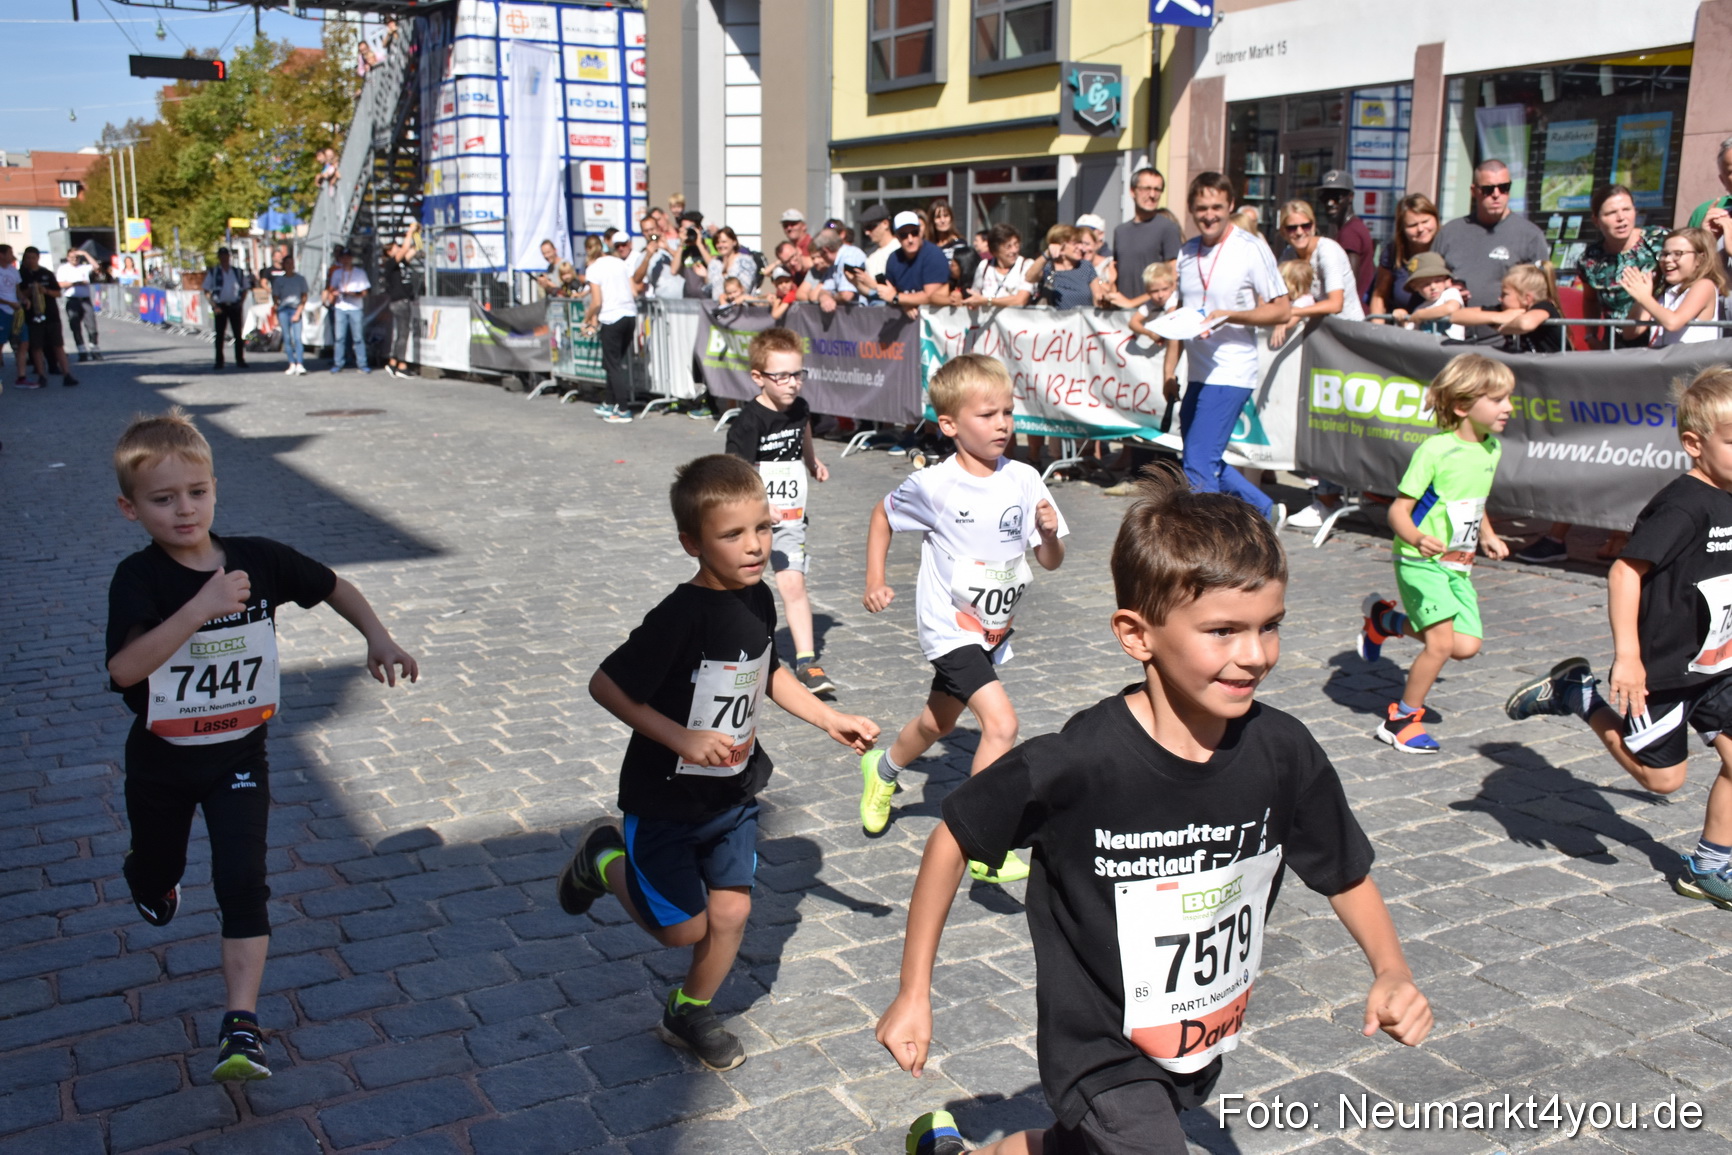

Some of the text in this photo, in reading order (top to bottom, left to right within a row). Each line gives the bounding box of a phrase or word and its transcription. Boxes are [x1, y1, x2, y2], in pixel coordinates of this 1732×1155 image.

[1215, 40, 1288, 65] Unterer Markt 15
[1351, 420, 1364, 438] by
[1367, 427, 1400, 441] smart
[1527, 440, 1692, 470] www.bockon
[766, 480, 799, 499] 443
[1463, 521, 1479, 542] 75
[190, 636, 247, 655] BOCK
[170, 656, 263, 702] 7447
[156, 696, 166, 704] B2
[179, 700, 246, 715] PARTL Neumarkt
[193, 717, 239, 734] Lasse
[231, 782, 257, 790] erima
[1094, 823, 1235, 850] Neumarkter
[1094, 849, 1207, 877] Stadtlauf
[1182, 875, 1244, 913] BOCK
[1154, 904, 1252, 994] 7579
[1135, 986, 1149, 998] B5
[1171, 979, 1243, 1015] PARTL Neumarkt
